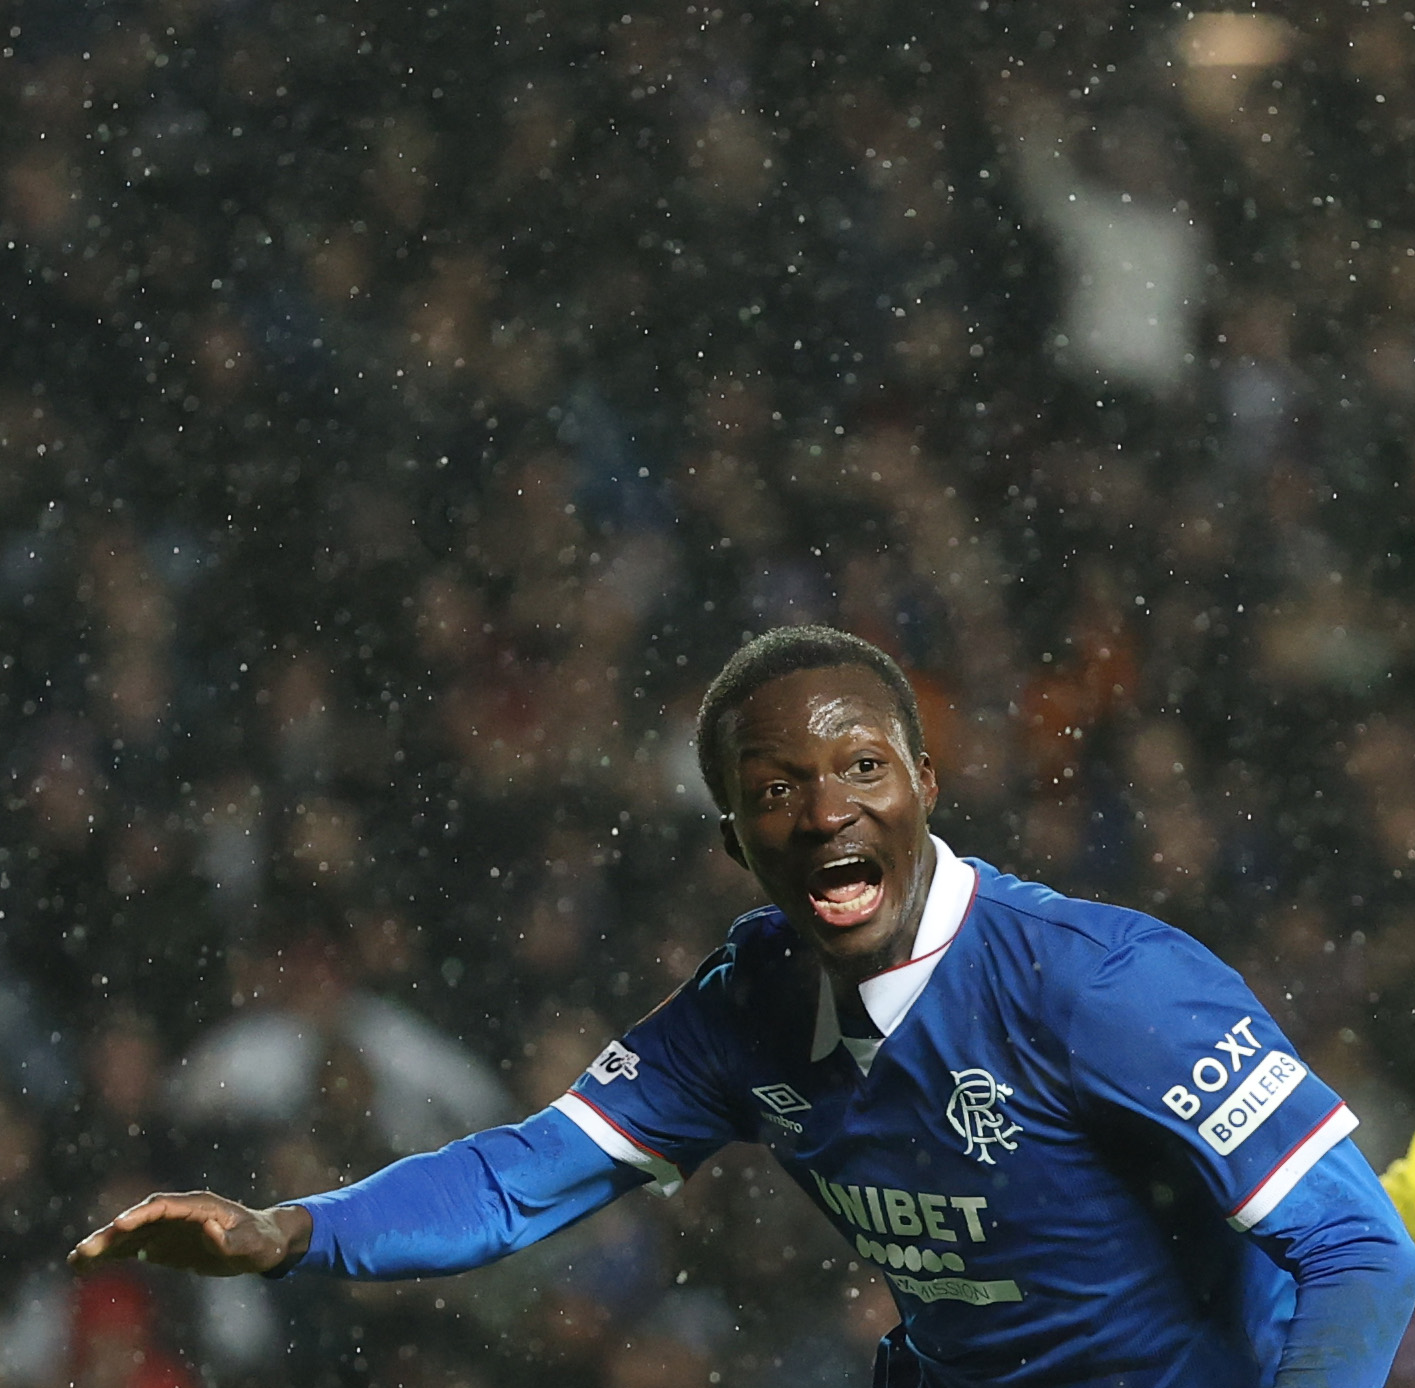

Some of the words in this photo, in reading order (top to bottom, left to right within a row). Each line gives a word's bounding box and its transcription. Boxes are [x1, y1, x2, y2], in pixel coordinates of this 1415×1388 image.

[1161, 1015, 1264, 1122] BOXT
[1212, 1055, 1297, 1145] BOILERS
[810, 1169, 988, 1243] UNIBET
